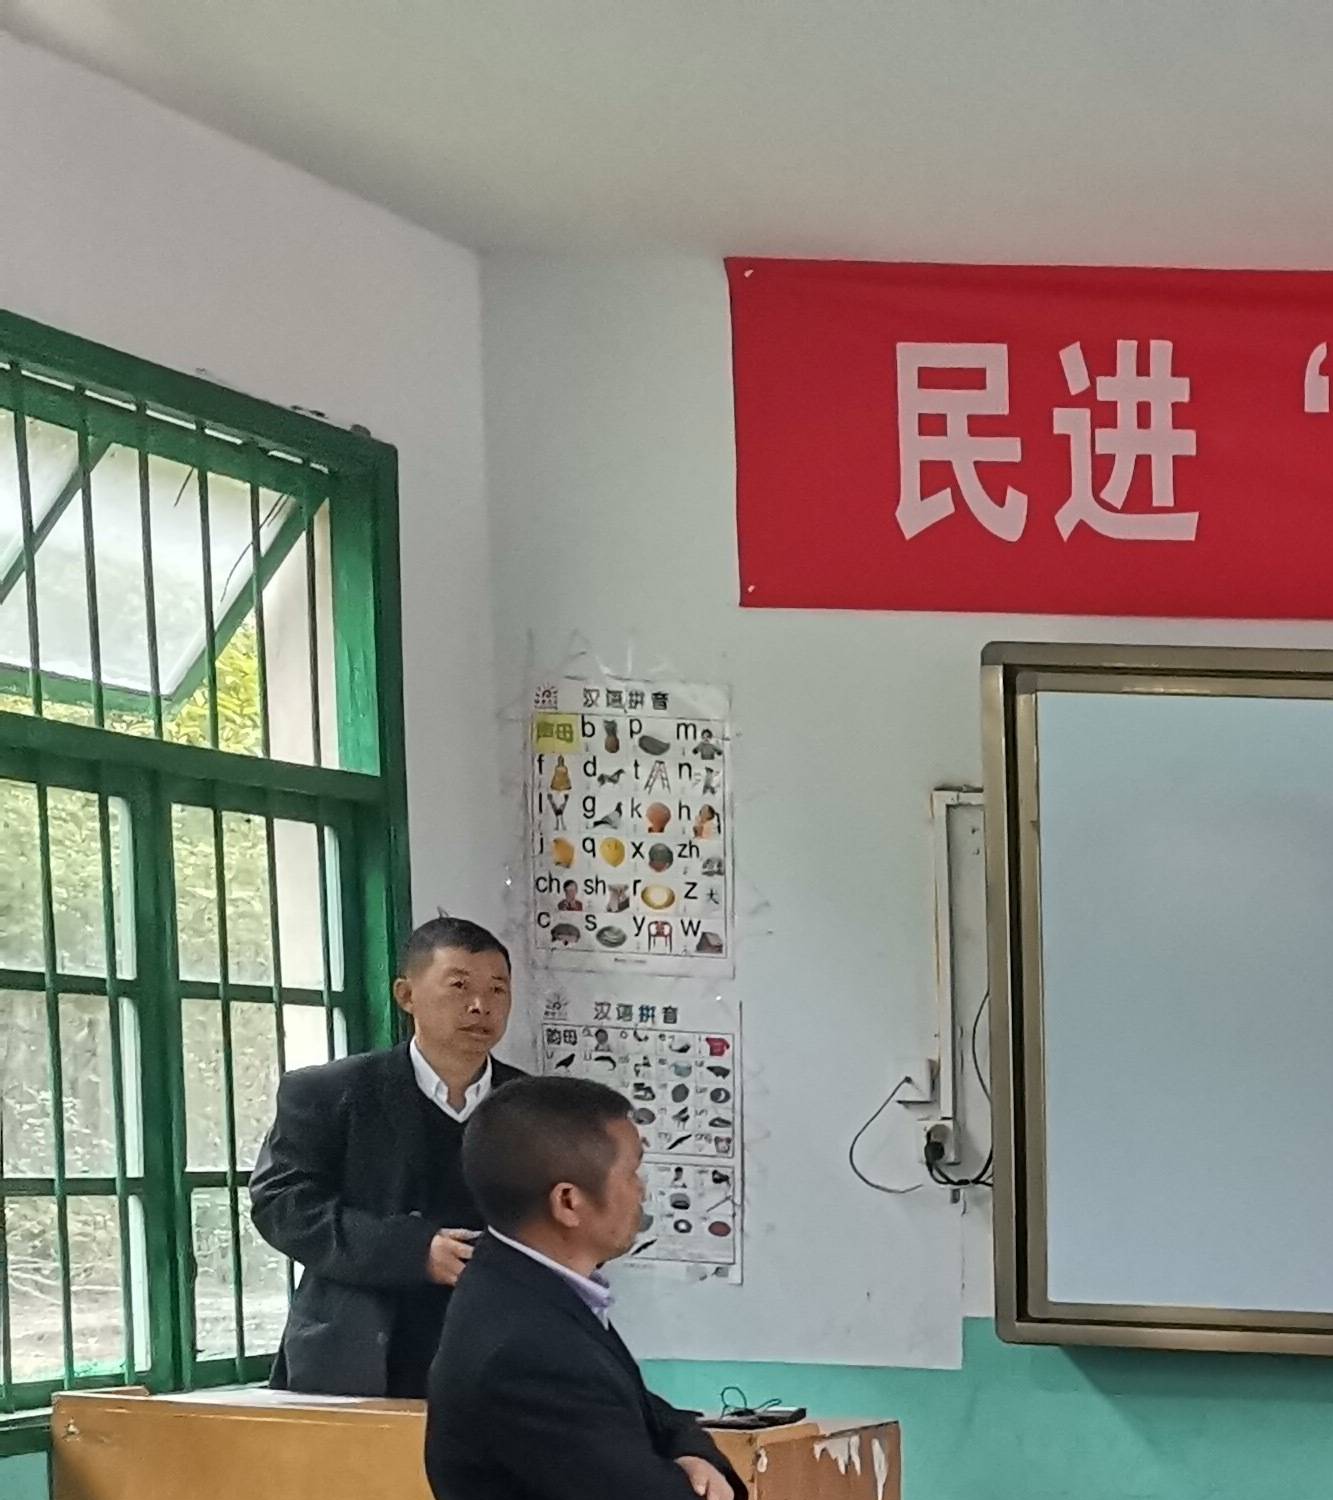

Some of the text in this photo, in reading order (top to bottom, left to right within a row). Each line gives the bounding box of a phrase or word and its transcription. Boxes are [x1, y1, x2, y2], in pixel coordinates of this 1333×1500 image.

[894, 338, 1200, 544] 民进
[581, 713, 697, 741] b p m
[536, 754, 692, 780] f d t n
[582, 795, 596, 819] g
[630, 796, 643, 819] k
[678, 800, 692, 821] h
[537, 836, 700, 860] j q x zh
[534, 871, 699, 900] ch sh r z
[537, 911, 701, 938] c s y w
